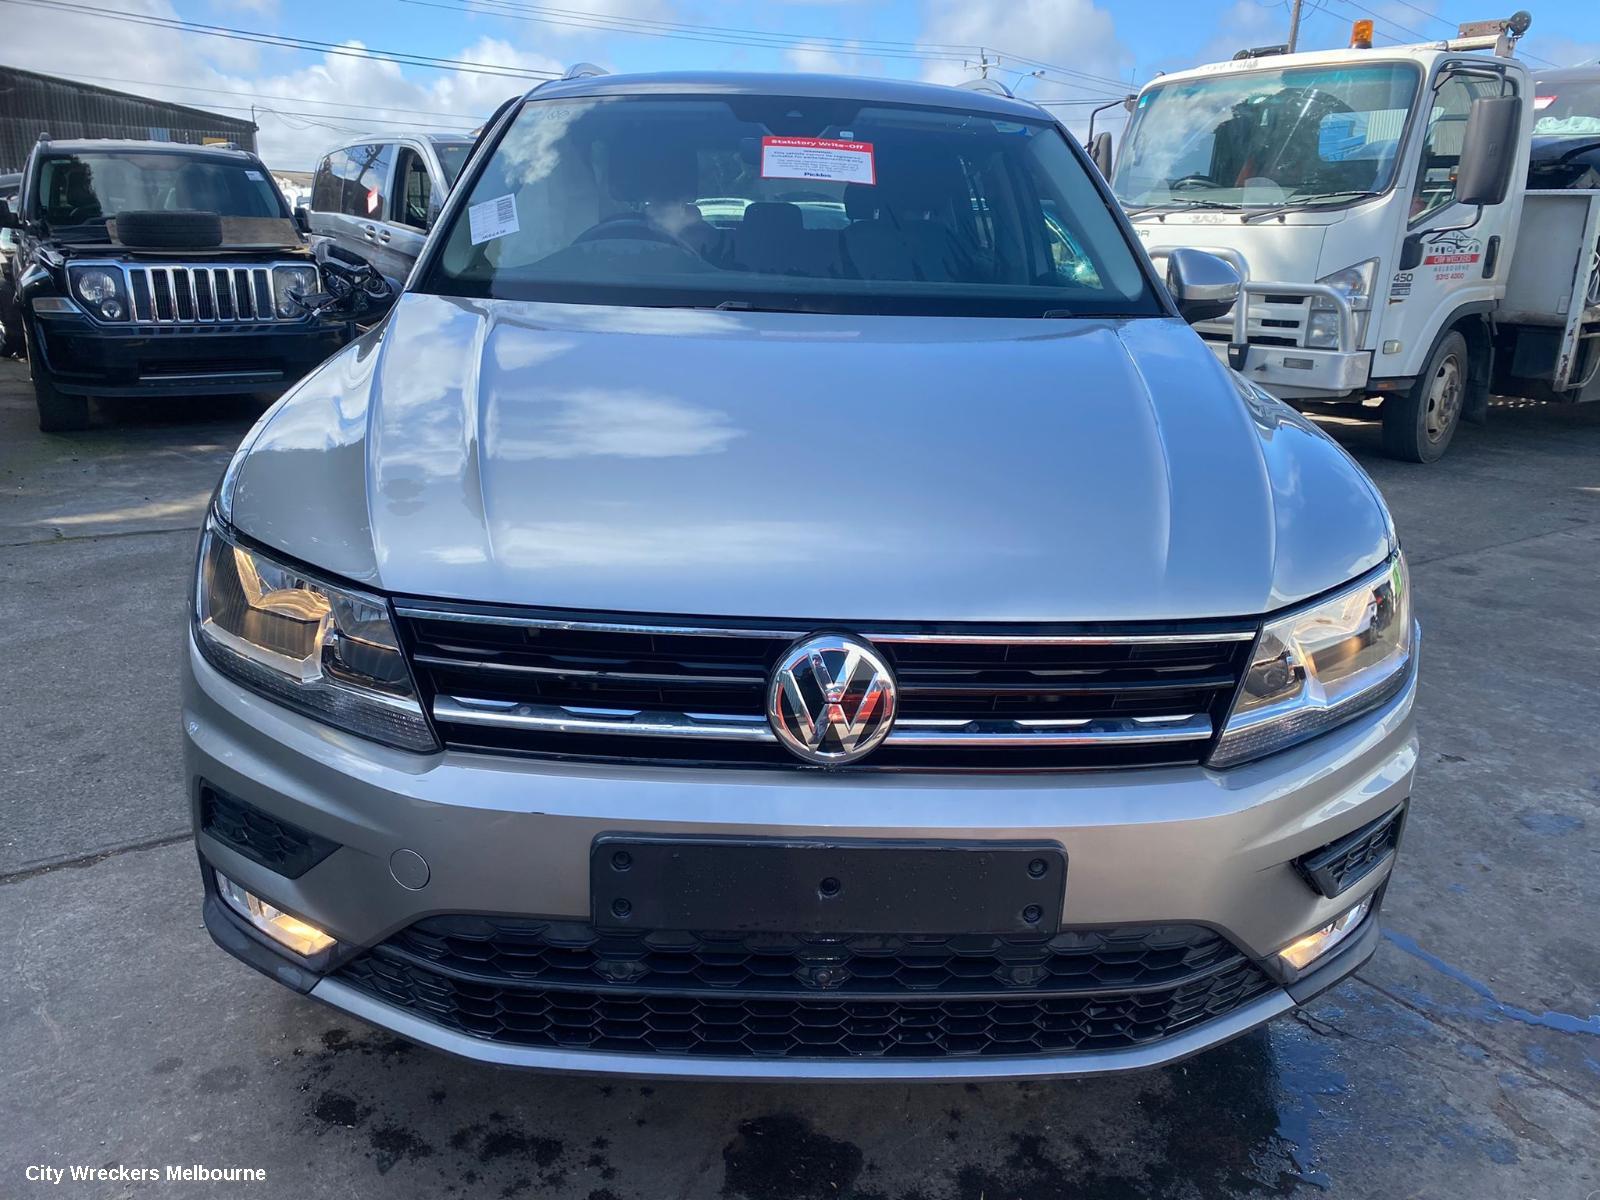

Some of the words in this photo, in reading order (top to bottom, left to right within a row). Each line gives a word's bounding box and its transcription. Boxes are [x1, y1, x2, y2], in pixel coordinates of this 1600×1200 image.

[771, 139, 817, 147] Statutory
[818, 141, 865, 150] Write-Off
[1393, 273, 1413, 282] 450
